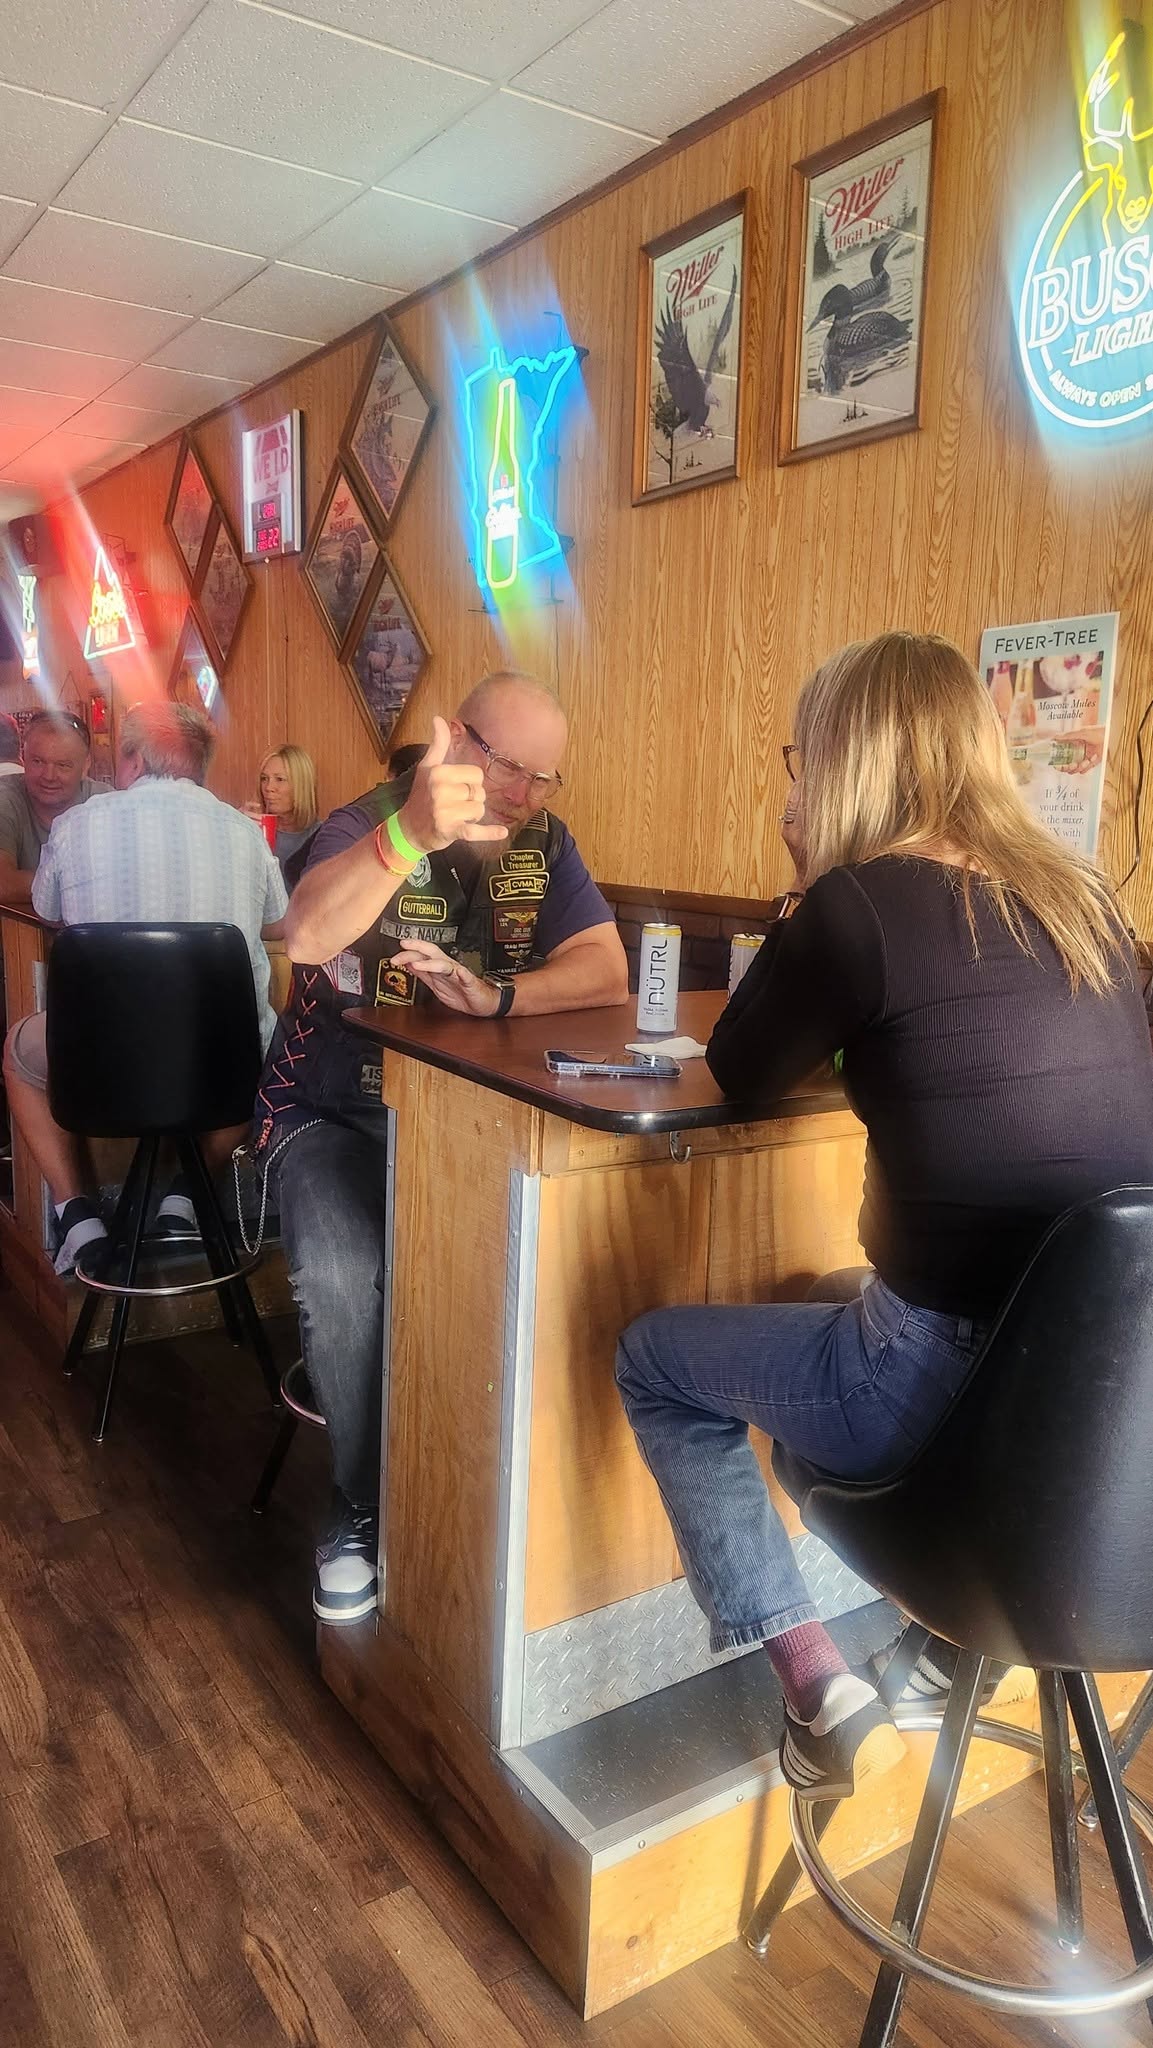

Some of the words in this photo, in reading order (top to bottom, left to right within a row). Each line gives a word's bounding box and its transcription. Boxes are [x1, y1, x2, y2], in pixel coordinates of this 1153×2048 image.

[825, 158, 904, 236] Miller
[835, 229, 863, 250] HIGH
[868, 214, 894, 235] LIFE
[666, 246, 724, 308] Miller
[1027, 235, 1153, 348] BUS
[698, 294, 717, 311] LIFE
[1068, 311, 1153, 366] LIGH
[1100, 380, 1142, 408] OPEN
[994, 628, 1099, 654] FEVER-TREE
[1037, 701, 1070, 712] Moscow
[1070, 698, 1097, 709] Mules
[1047, 709, 1084, 721] Available
[1069, 788, 1080, 799] of
[1039, 804, 1059, 815] your
[1060, 802, 1085, 812] drink
[1046, 814, 1060, 824] the
[1062, 827, 1081, 838] with
[507, 861, 539, 870] Treasurer
[509, 853, 535, 863] Chapter
[511, 880, 534, 889] CVMA
[402, 901, 443, 916] GUTTERBALL
[395, 924, 413, 939] U.S.
[417, 927, 445, 942] NAVY
